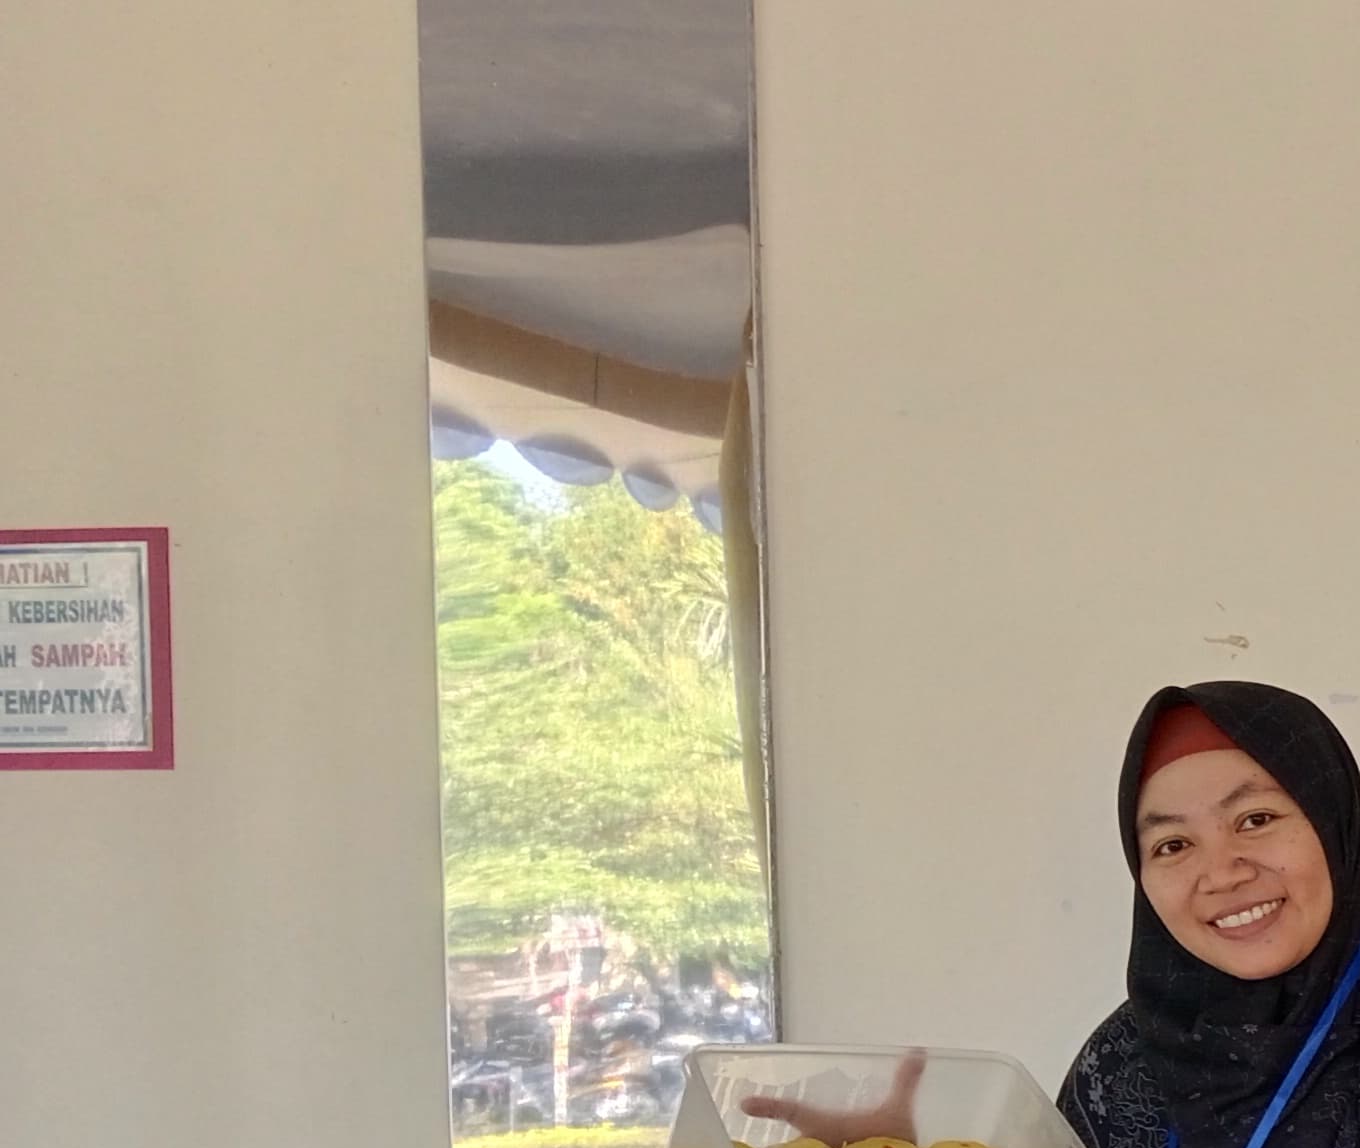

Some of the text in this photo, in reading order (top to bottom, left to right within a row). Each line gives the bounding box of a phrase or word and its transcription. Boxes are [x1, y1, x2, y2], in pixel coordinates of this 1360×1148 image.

[8, 599, 124, 624] KEBERSIHAN
[31, 643, 127, 668] SAMPAH
[0, 688, 127, 715] EMPATNYA
